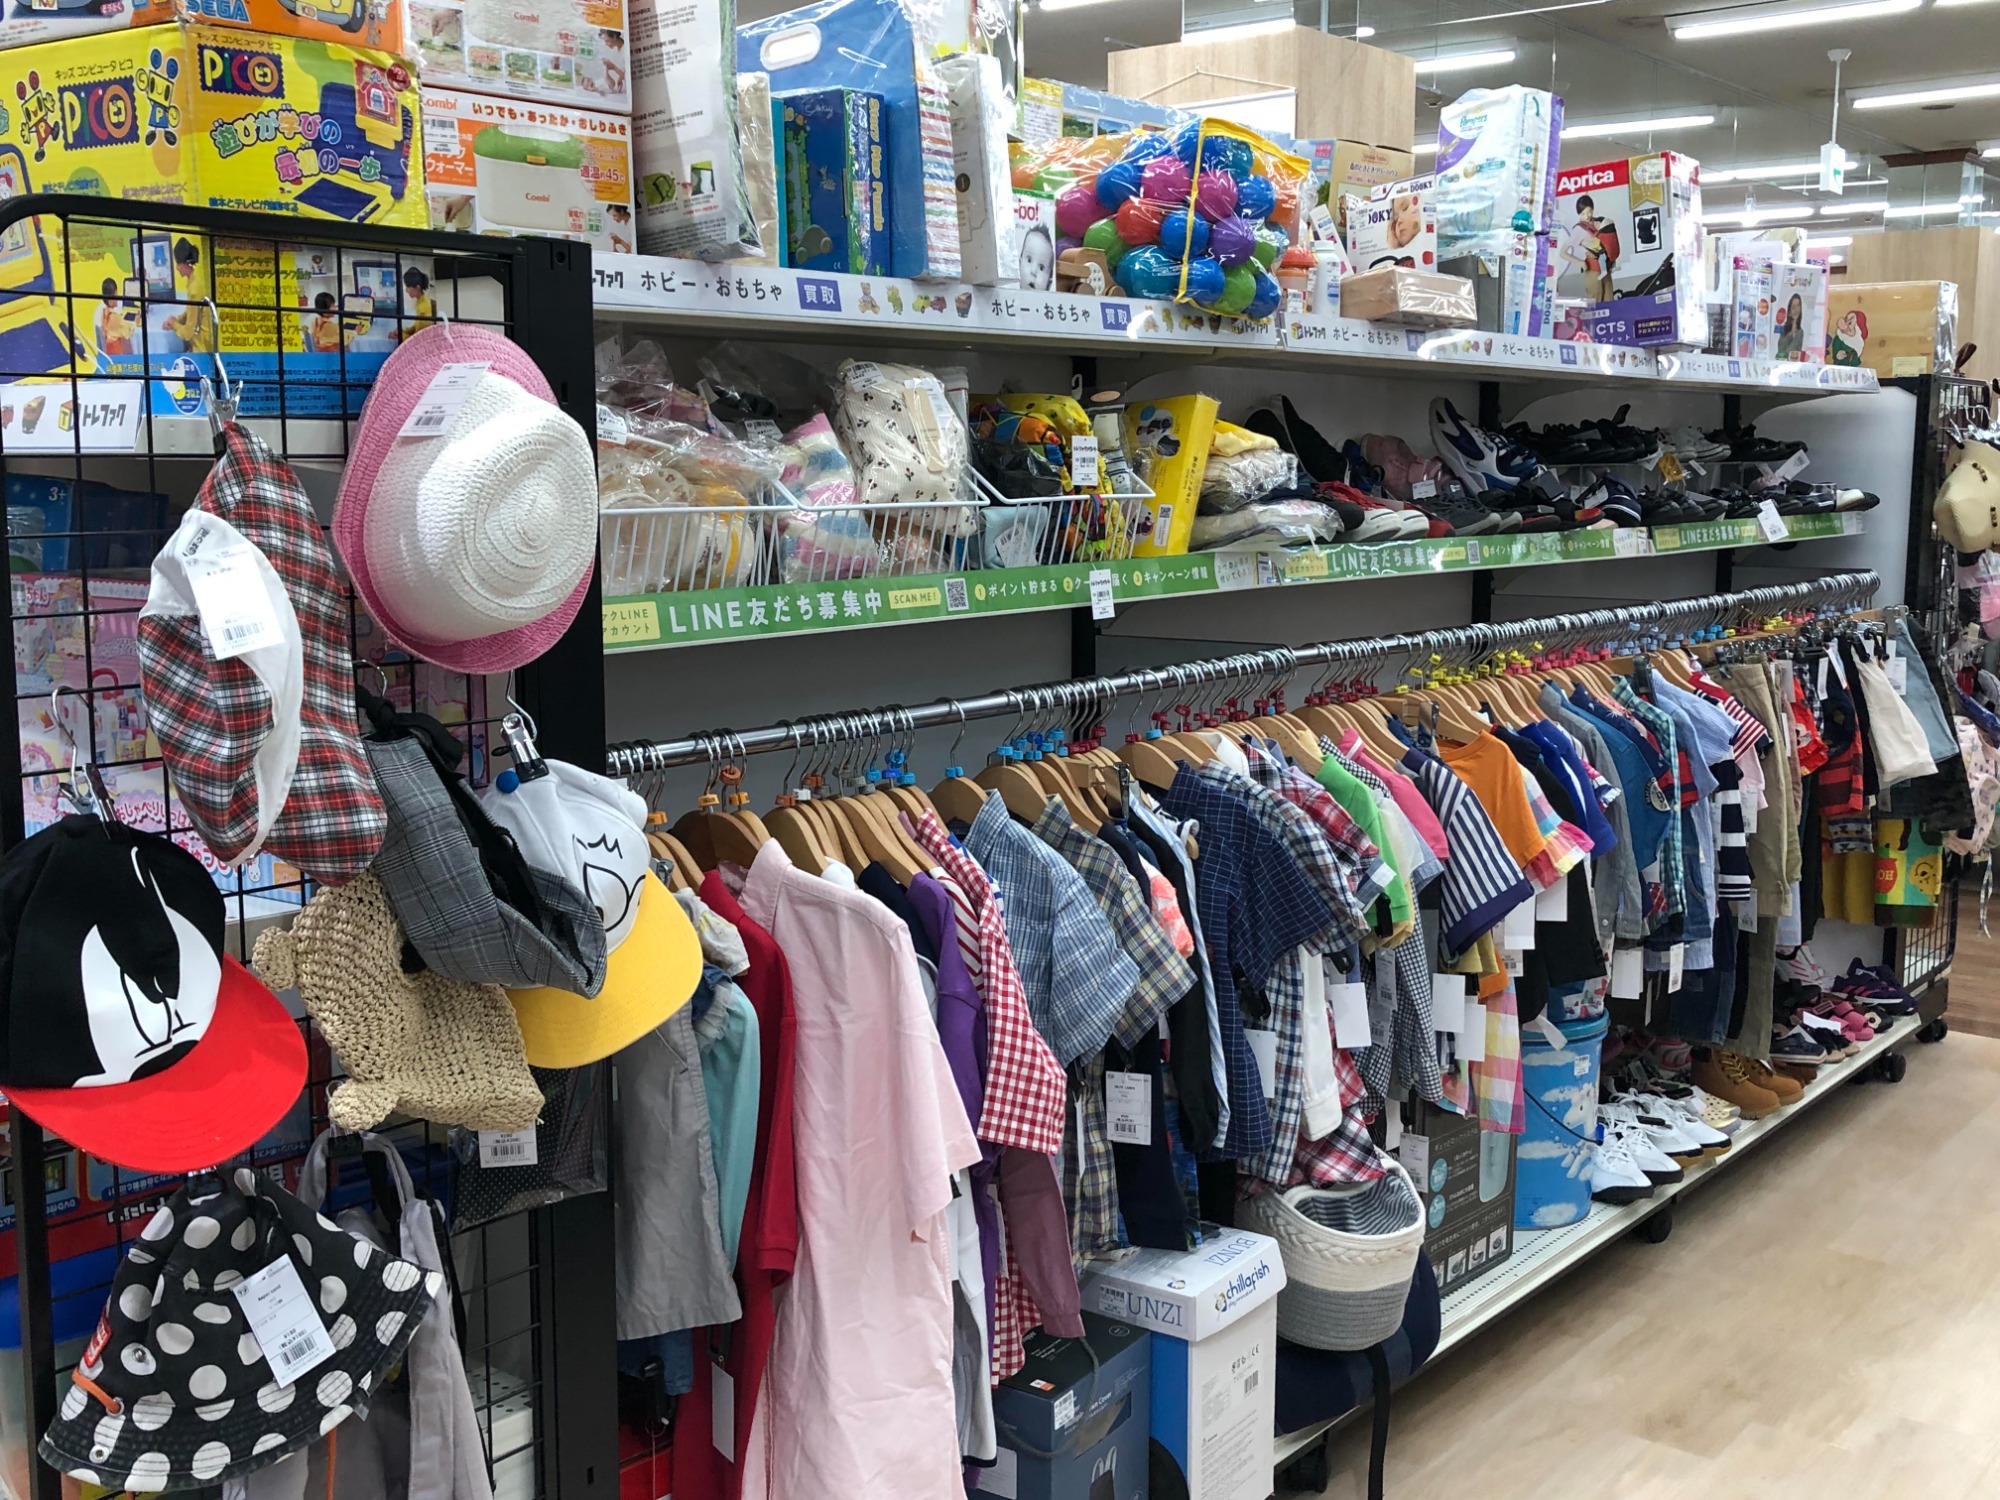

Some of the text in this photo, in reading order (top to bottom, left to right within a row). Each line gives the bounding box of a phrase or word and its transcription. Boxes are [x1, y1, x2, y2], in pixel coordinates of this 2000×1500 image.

[186, 0, 249, 23] SEGA
[514, 11, 540, 24] Combi
[424, 98, 457, 110] ombi
[472, 103, 627, 136] いつでも・あったか・おしりふき
[1460, 114, 1488, 127] Pampers
[1557, 169, 1614, 193] Aprica
[525, 193, 550, 203] Combi
[593, 270, 624, 288] ファク
[640, 271, 836, 305] ホビー・おもちゃ 買取
[991, 298, 1091, 323] ホビー・おもちゃ
[1333, 326, 1399, 345] ホビー・おもちゃ
[1596, 320, 1627, 335] CTS
[1502, 342, 1555, 359] ホビー・おもちゃ
[82, 403, 127, 428] トレファク
[48, 487, 67, 501] 3+
[1144, 565, 1209, 583] キャンペーン情報
[988, 577, 1058, 598] ポイント貯まる
[893, 592, 918, 605] SCAN
[669, 588, 883, 634] LINE友だち募集中
[1203, 1236, 1259, 1267] BUNZI
[1226, 1259, 1271, 1301] chillafish
[1126, 1291, 1184, 1327] UNZI
